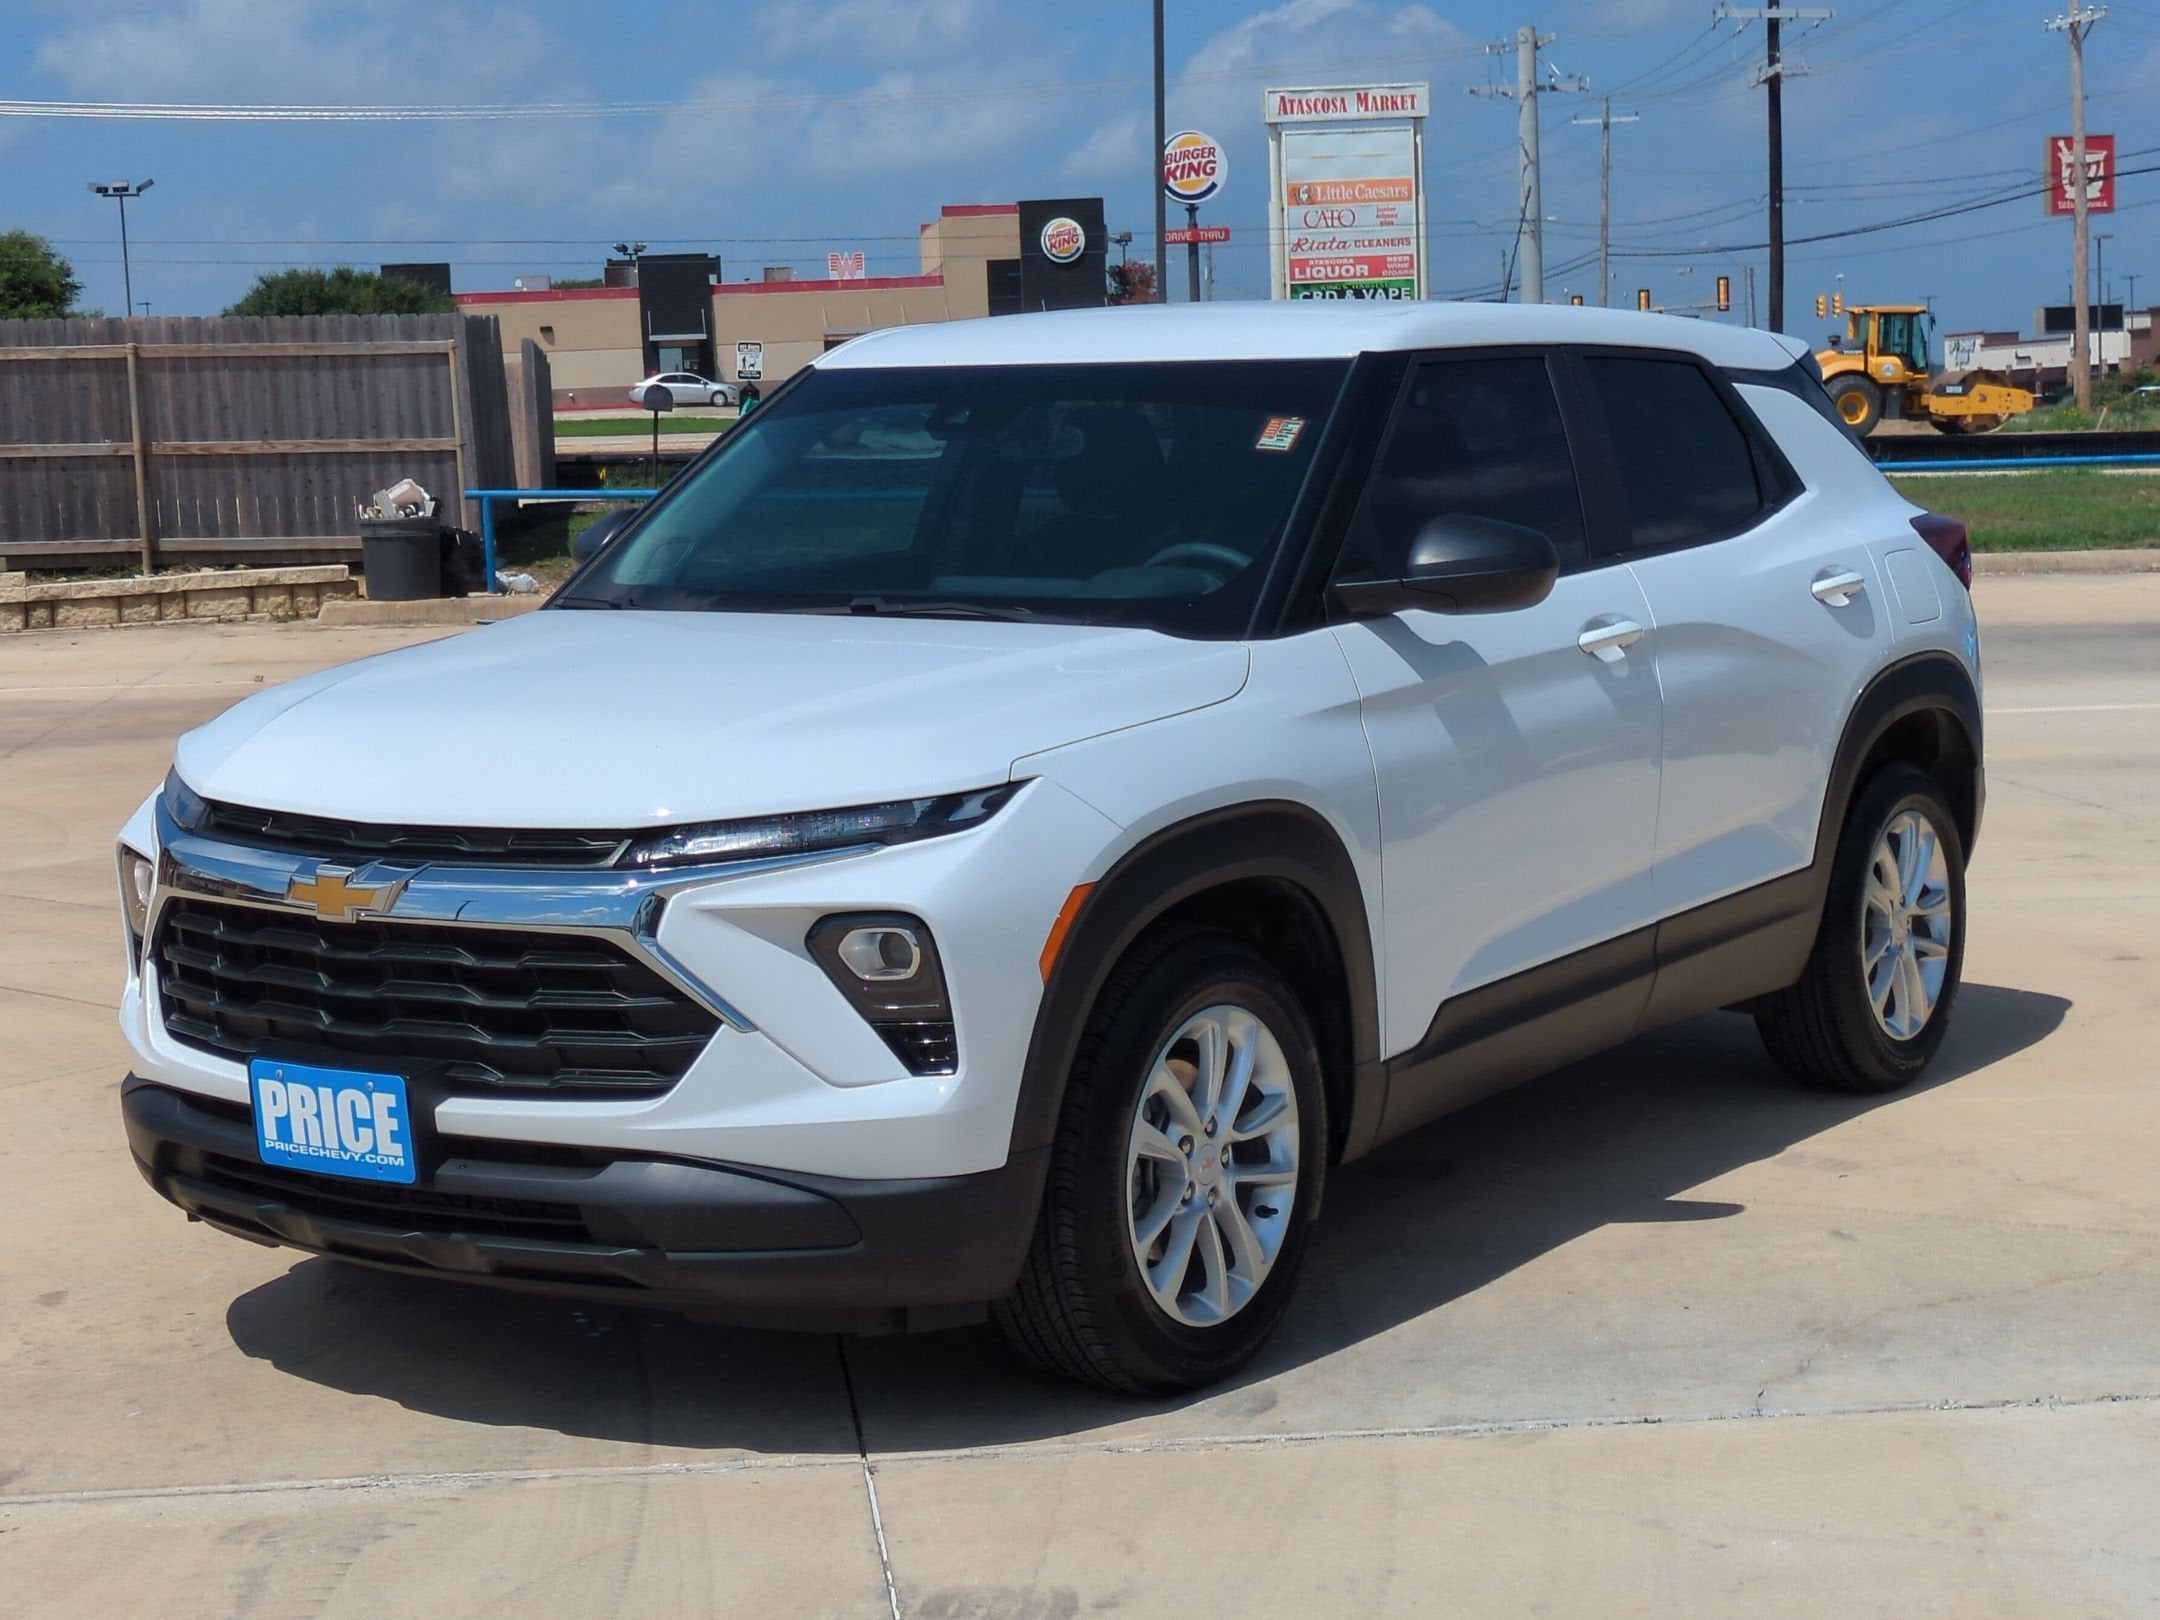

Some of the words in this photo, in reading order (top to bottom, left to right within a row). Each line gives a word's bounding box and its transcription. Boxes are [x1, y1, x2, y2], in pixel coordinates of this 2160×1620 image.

[1277, 95, 1348, 116] ATASCOSA
[1356, 92, 1417, 112] MARKET
[1165, 147, 1216, 166] BURGER
[1165, 160, 1217, 184] KING
[1317, 185, 1354, 201] Little
[1355, 183, 1409, 200] Caesars
[1303, 208, 1356, 229] CATO
[1050, 234, 1079, 251] KING
[1165, 231, 1192, 242] DRIVE
[1198, 230, 1226, 241] THRU
[1354, 237, 1412, 249] CLEANERS
[1294, 264, 1369, 280] LIQUOR
[1362, 288, 1411, 300] VAPE
[258, 1078, 404, 1157] PRICE
[265, 1140, 405, 1167] PRICECHEVY.COM
